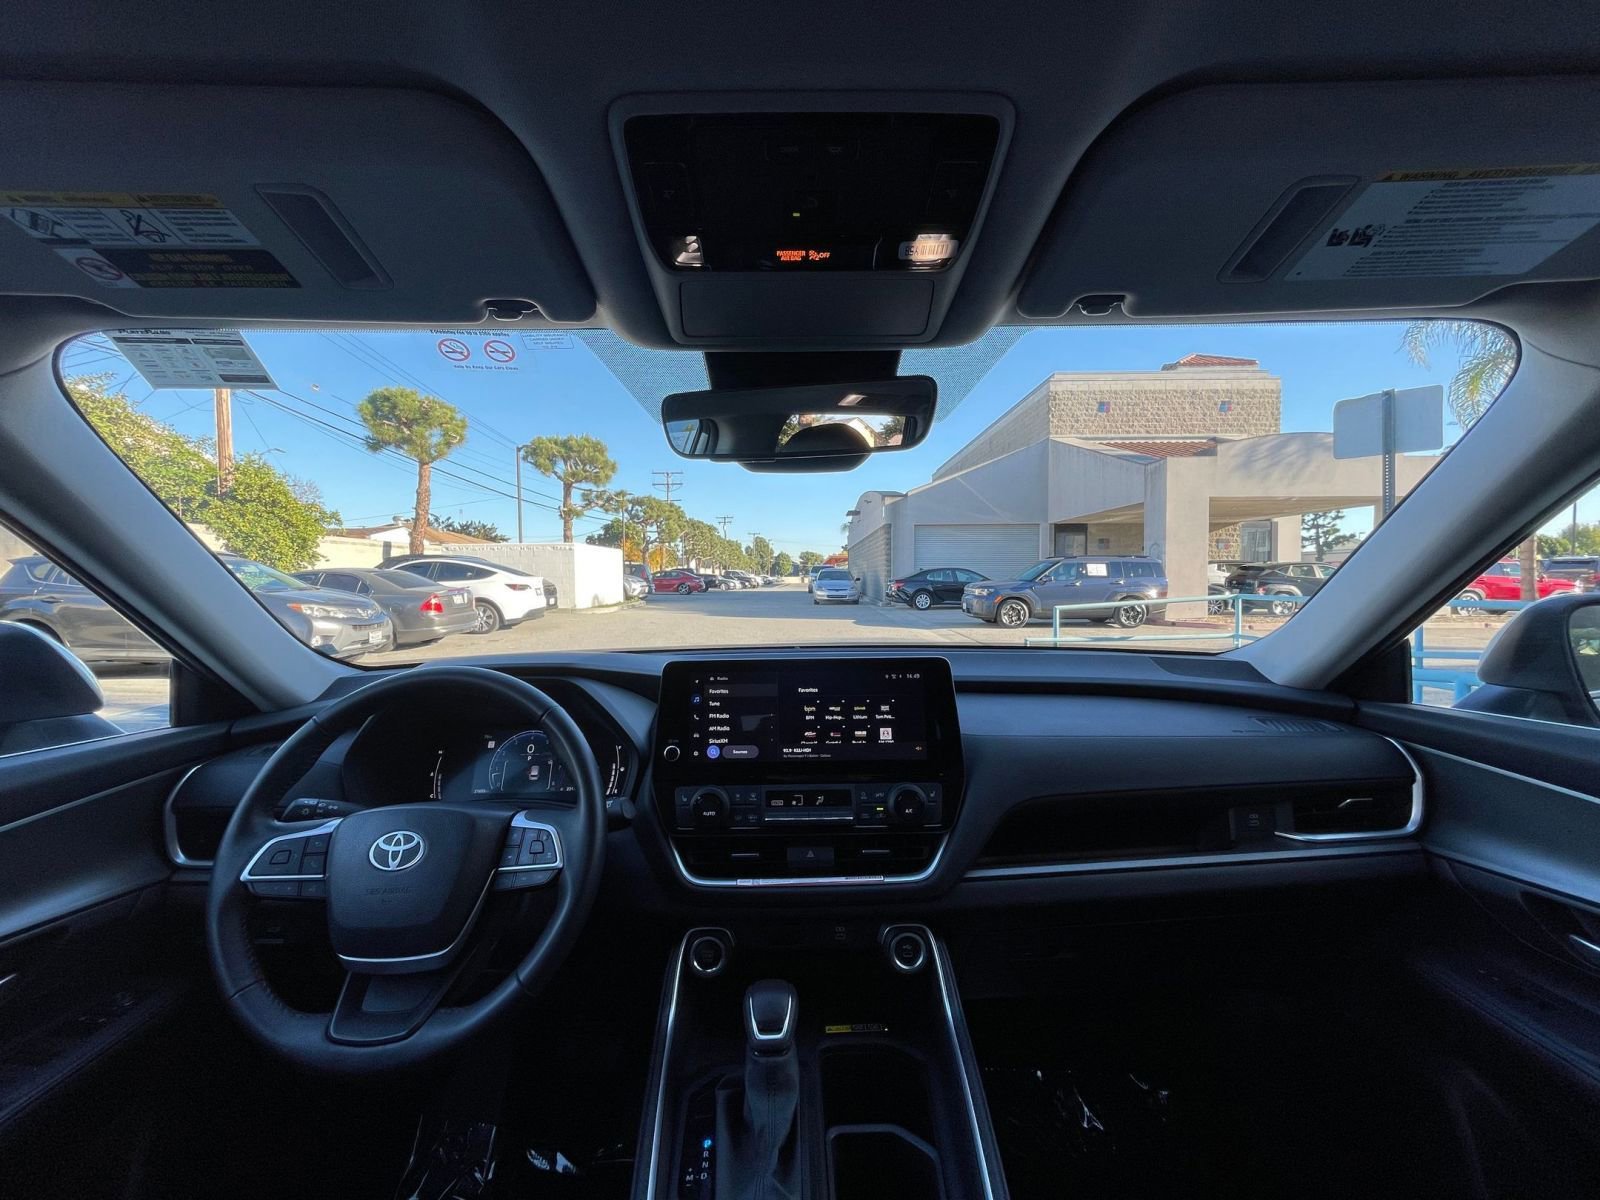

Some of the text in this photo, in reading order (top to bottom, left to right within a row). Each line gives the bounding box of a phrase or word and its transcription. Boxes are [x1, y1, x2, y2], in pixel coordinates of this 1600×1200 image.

[527, 743, 535, 753] 0
[704, 1139, 712, 1148] P
[703, 1150, 709, 1158] R
[701, 1160, 709, 1169] N
[685, 1172, 708, 1182] M D
